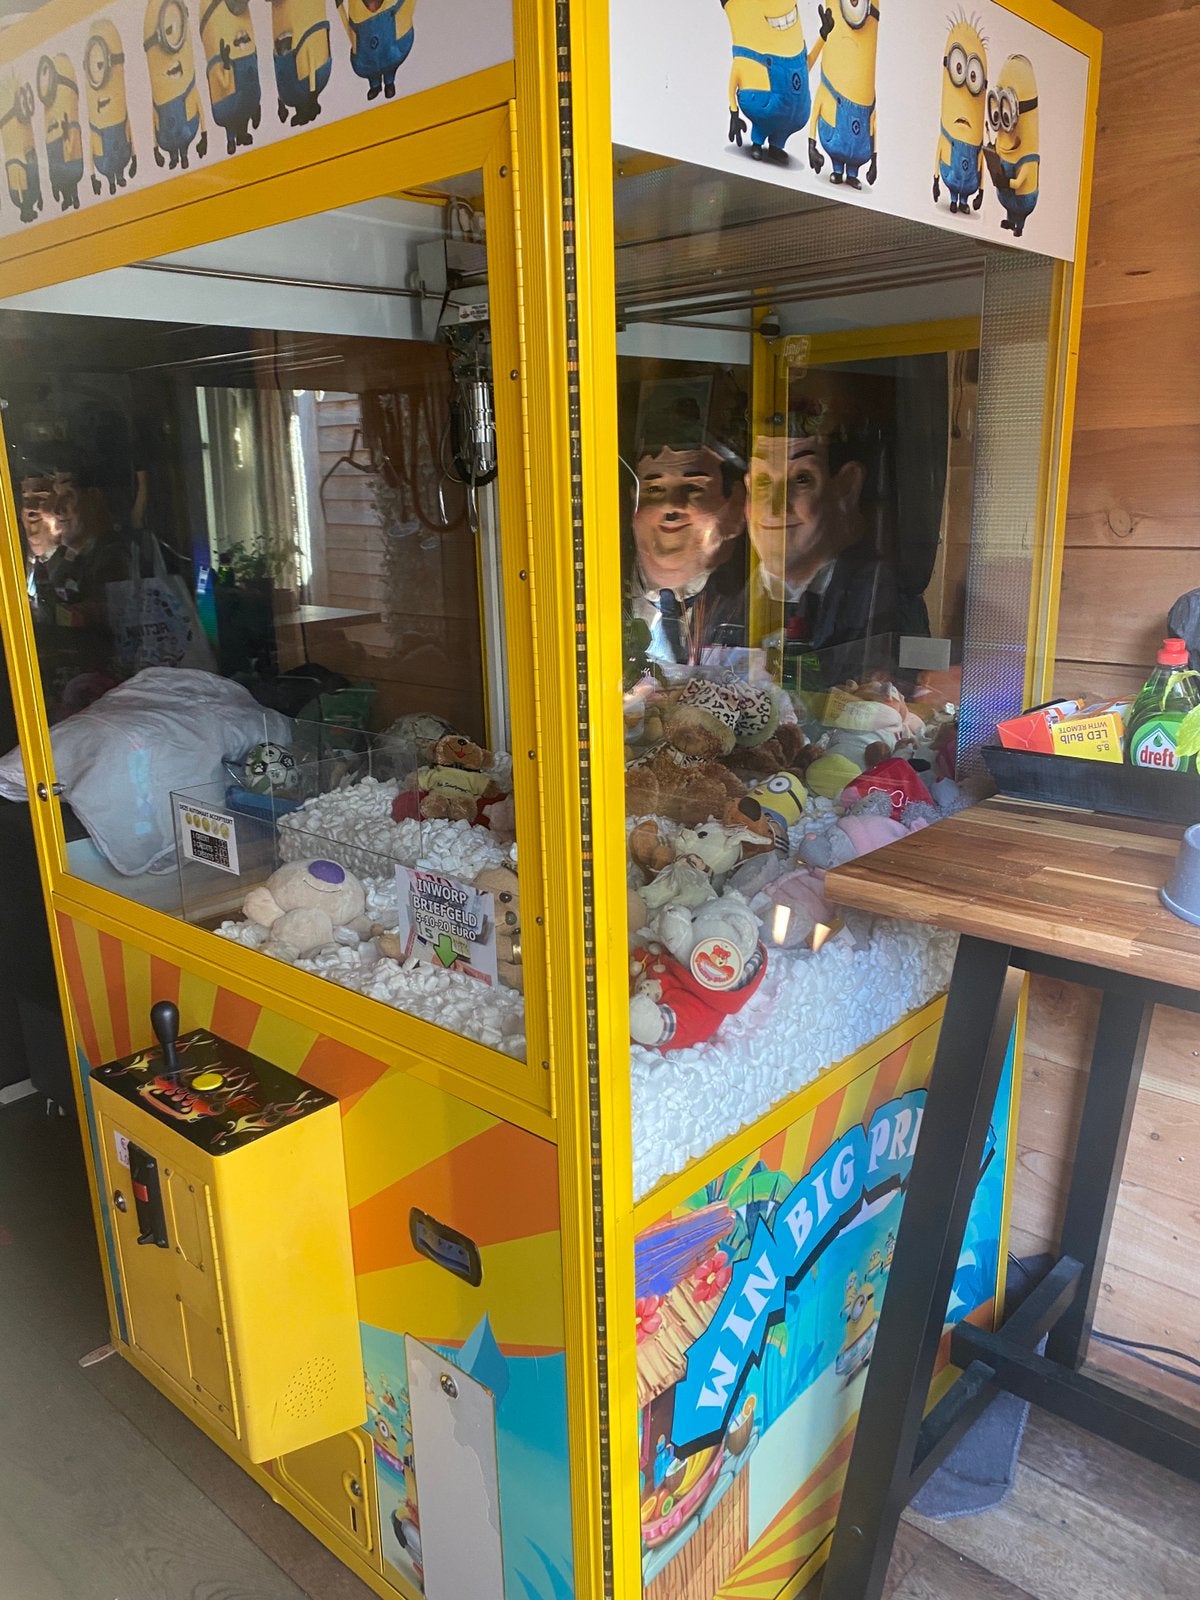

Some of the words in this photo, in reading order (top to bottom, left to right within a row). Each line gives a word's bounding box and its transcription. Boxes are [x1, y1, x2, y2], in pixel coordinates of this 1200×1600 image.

[1059, 723, 1087, 734] REMOTE
[1087, 721, 1107, 731] WITH
[1060, 731, 1084, 744] Bulb
[1087, 729, 1108, 741] LED
[1096, 743, 1110, 753] 8.5
[1140, 746, 1174, 768] dreft
[416, 878, 468, 905] INWORP
[412, 895, 478, 928] BRIEFGELD
[416, 912, 450, 932] 5-10-20
[450, 924, 477, 941] EURO
[696, 1252, 779, 1411] WIN
[783, 1145, 855, 1259] BIG
[867, 1107, 925, 1174] PRI
